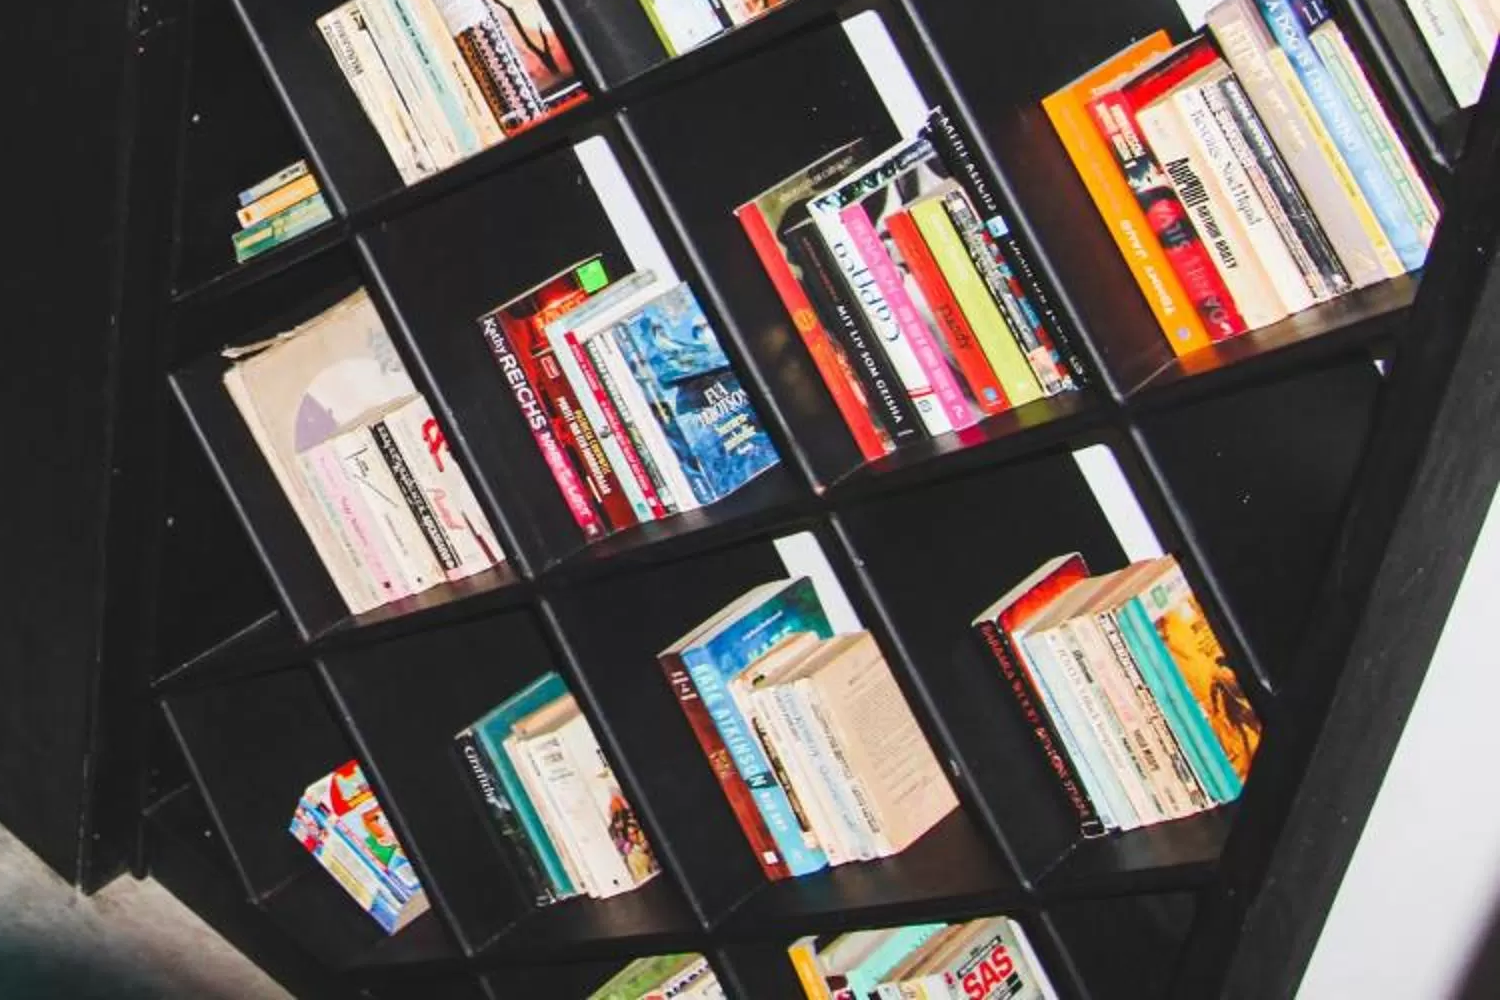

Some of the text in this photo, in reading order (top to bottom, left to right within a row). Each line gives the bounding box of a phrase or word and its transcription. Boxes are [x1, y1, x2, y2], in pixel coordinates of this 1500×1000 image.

[478, 316, 509, 357] Kathy
[497, 351, 547, 432] REICHS
[835, 303, 904, 423] MIT LIV SOM GEISHA
[710, 704, 768, 791] ATKINSON
[961, 945, 1014, 1000] SAS
